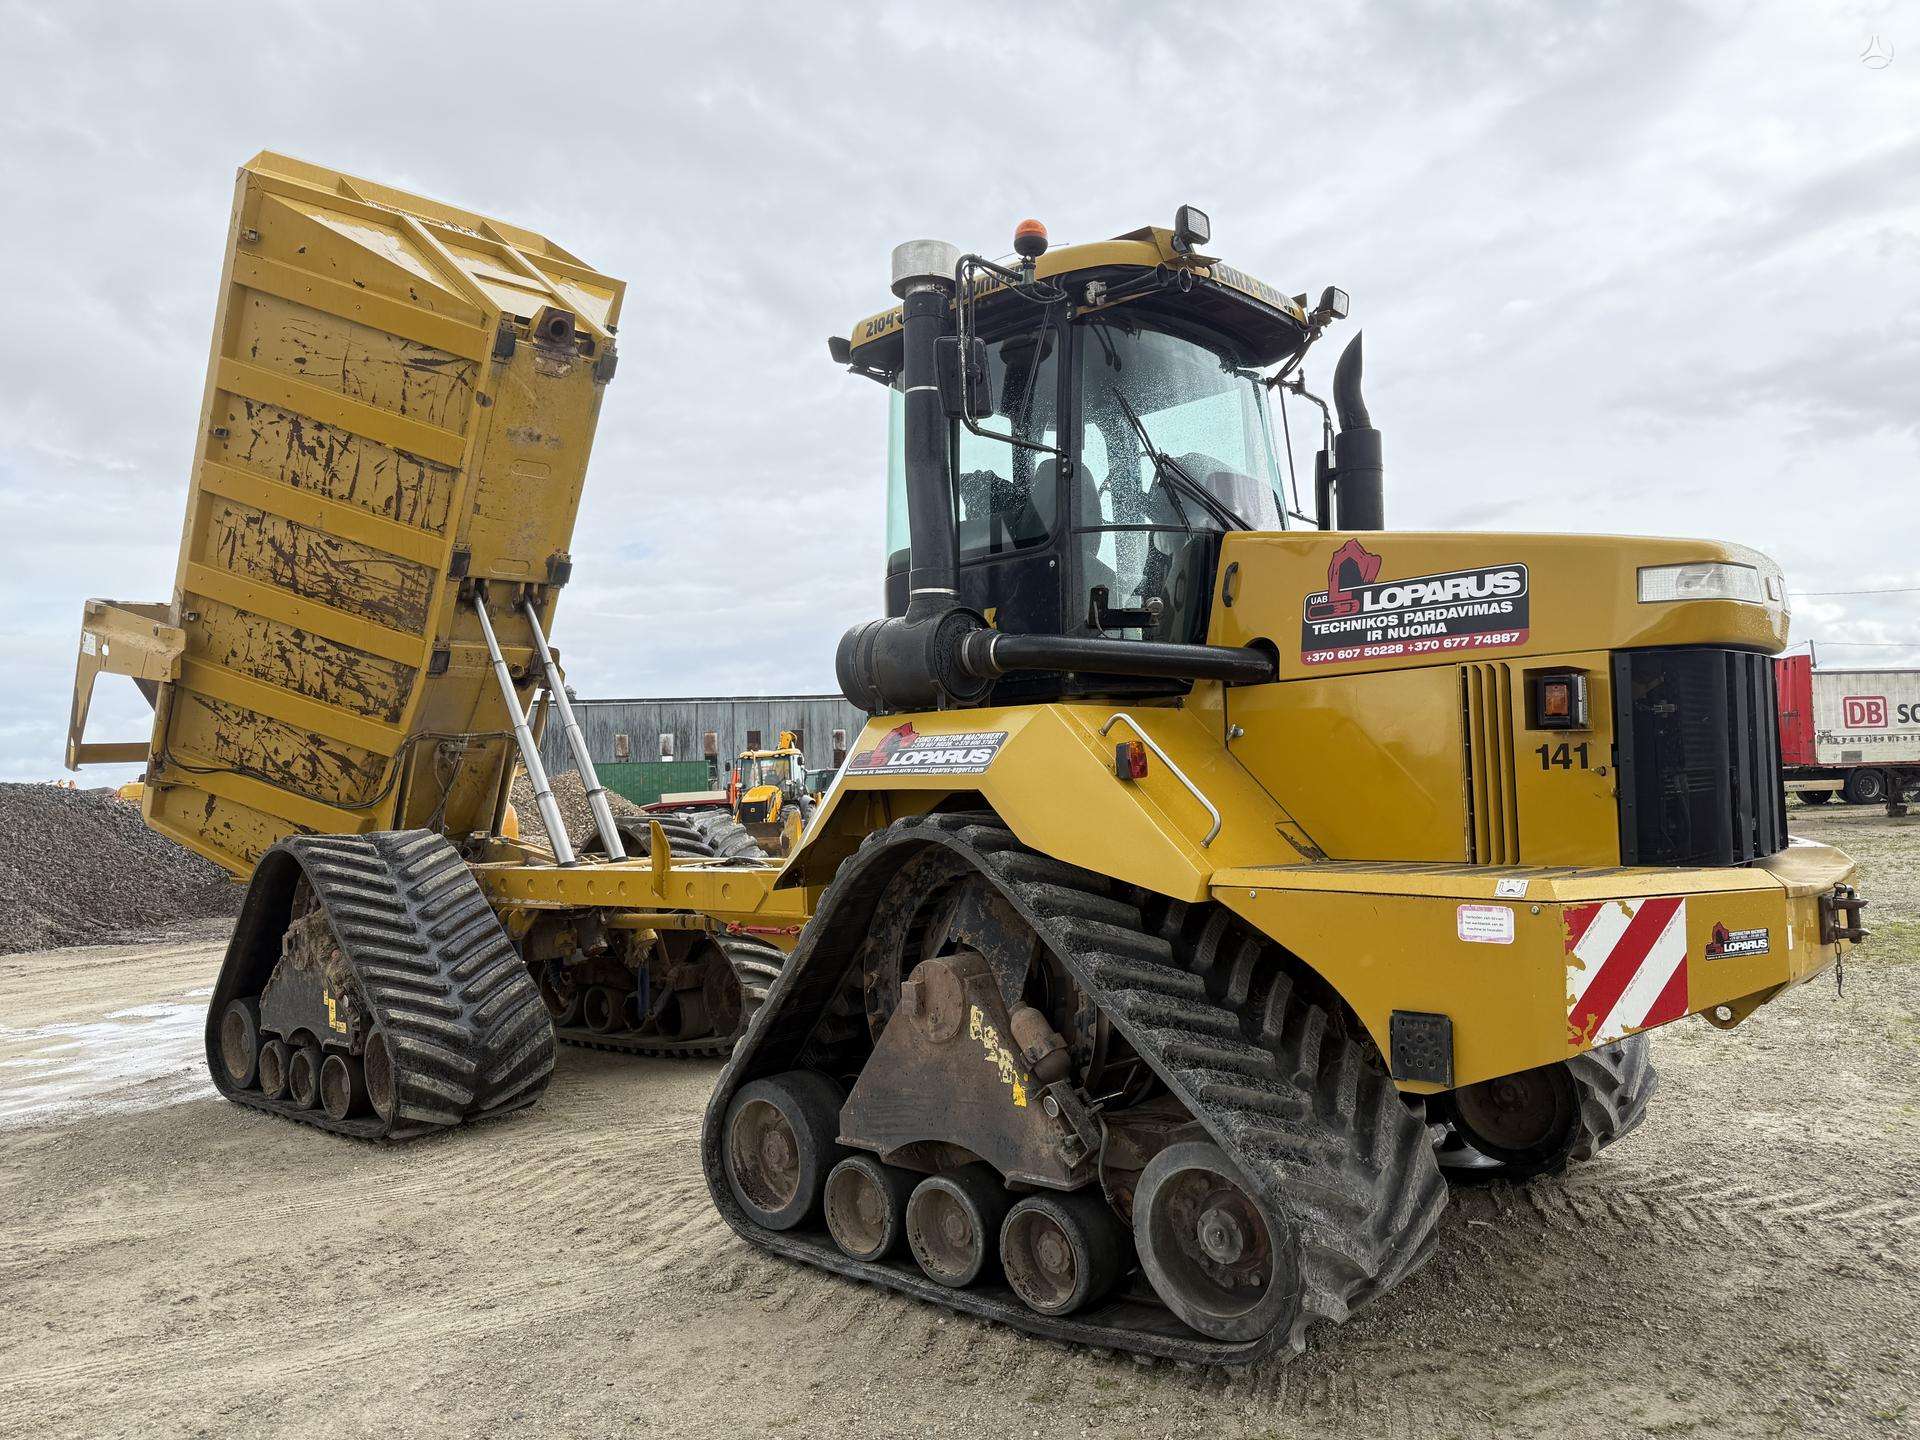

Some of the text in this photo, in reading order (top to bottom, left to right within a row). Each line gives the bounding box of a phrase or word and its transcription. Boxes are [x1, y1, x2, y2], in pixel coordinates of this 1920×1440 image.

[866, 314, 895, 338] 2104
[1310, 595, 1328, 605] UAB
[1363, 571, 1521, 612] LOPARUS
[1312, 600, 1514, 636] TECHNIKOS PARDAVIMAS
[1367, 622, 1448, 642] IR NUOMA
[1306, 632, 1520, 663] +370 607 50228 +370 677 74887
[1848, 701, 1883, 724] DB
[914, 732, 1005, 744] CONSTRUCTION MACHINERY
[887, 748, 992, 766] LOPARUS
[1535, 742, 1589, 770] 141
[1724, 939, 1768, 952] LOPARUS
